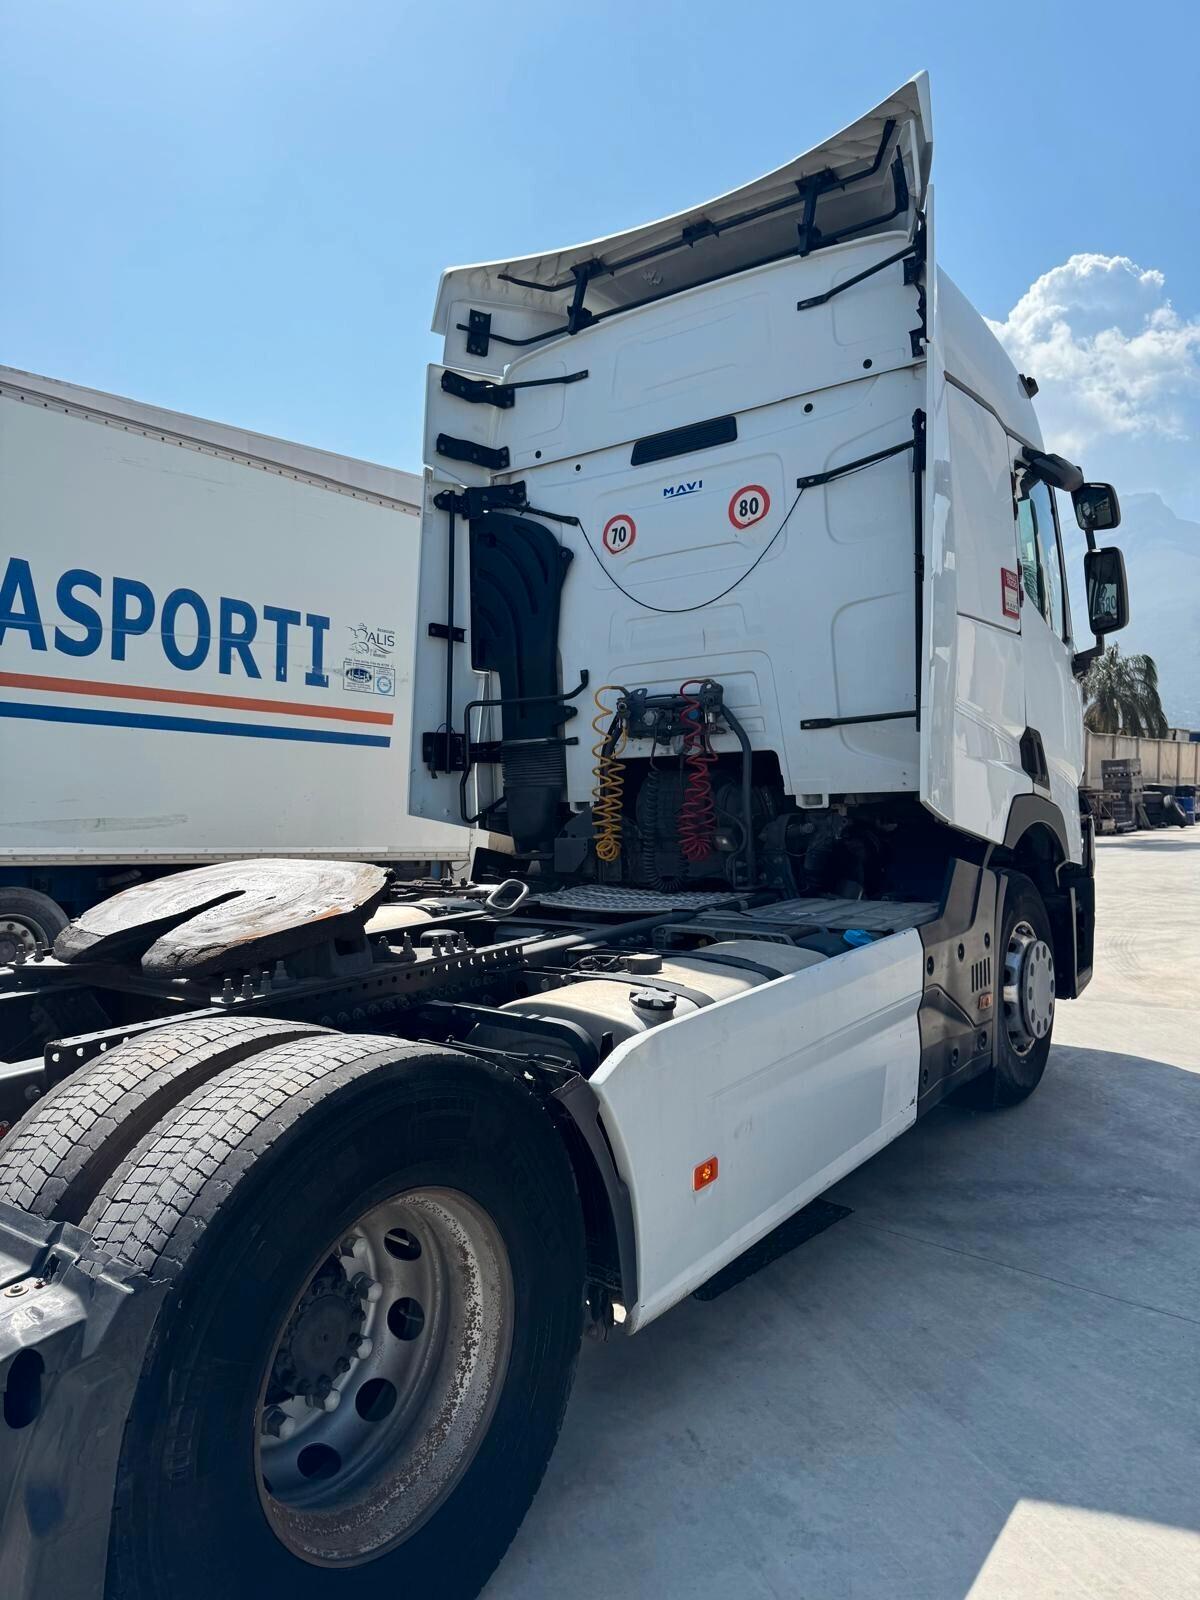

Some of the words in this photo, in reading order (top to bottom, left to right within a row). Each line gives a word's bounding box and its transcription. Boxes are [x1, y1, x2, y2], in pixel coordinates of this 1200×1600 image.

[663, 480, 703, 497] MAVI
[739, 497, 759, 517] 80
[611, 526, 627, 545] 70
[0, 557, 330, 688] ASPORTI
[367, 632, 395, 647] ALIS
